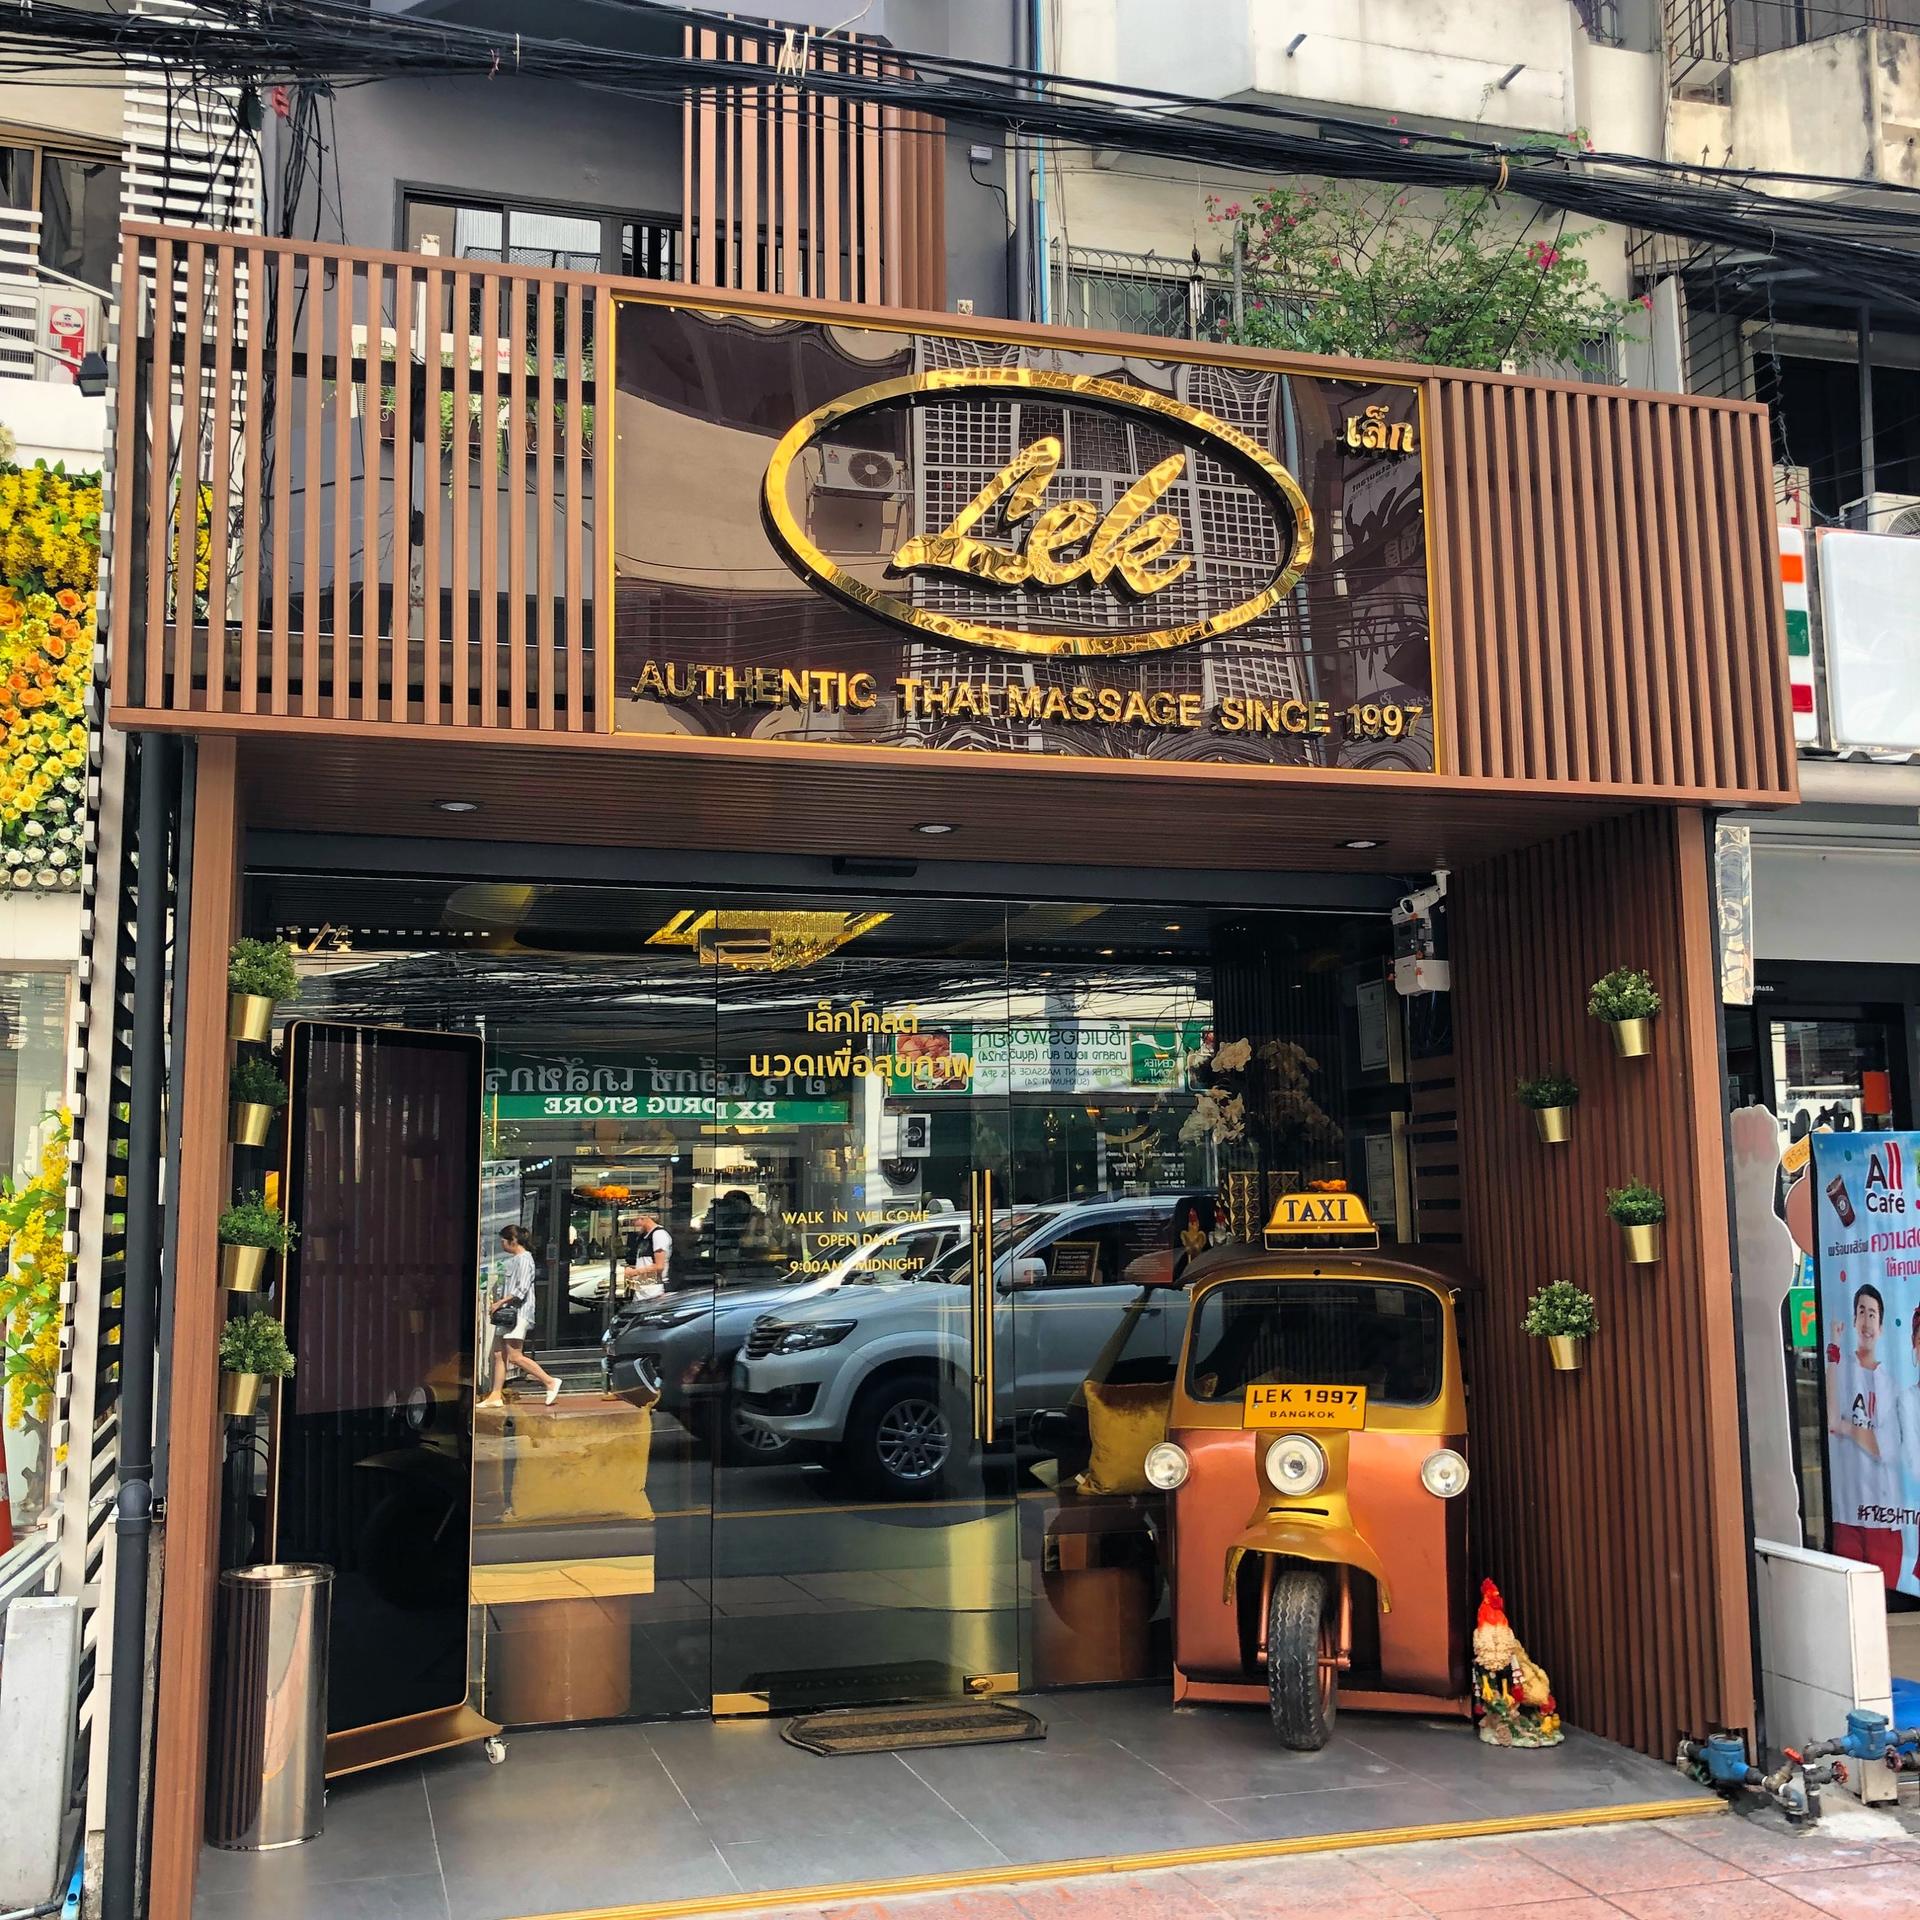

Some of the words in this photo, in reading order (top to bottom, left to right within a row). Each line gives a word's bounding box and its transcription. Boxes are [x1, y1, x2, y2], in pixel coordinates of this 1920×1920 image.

[1347, 405, 1415, 452] เล็ก
[892, 436, 1191, 594] Lek
[635, 660, 877, 708] AUTHENTIC
[896, 677, 990, 716] THAI
[1008, 684, 1202, 727] MASSAGE
[1220, 696, 1332, 734] SINCE
[1347, 702, 1424, 737] 1997
[807, 999, 919, 1033] เล็กโกลด์
[750, 1039, 975, 1086] นวดเพื่อสุขภาพ
[1865, 1142, 1903, 1190] All
[1283, 1199, 1348, 1222] TAXI
[1866, 1191, 1905, 1213] Café
[782, 1211, 824, 1224] WALK
[832, 1211, 848, 1223] IN
[856, 1210, 930, 1223] WELCOME
[818, 1234, 857, 1247] OPEN
[862, 1233, 900, 1246] DAILY
[856, 1257, 926, 1272] MIDNIGHT
[1886, 1257, 1920, 1281] ให้คุณ
[1253, 1389, 1292, 1404] LEK
[1304, 1389, 1358, 1405] 1997
[1269, 1410, 1335, 1419] BANGKOK
